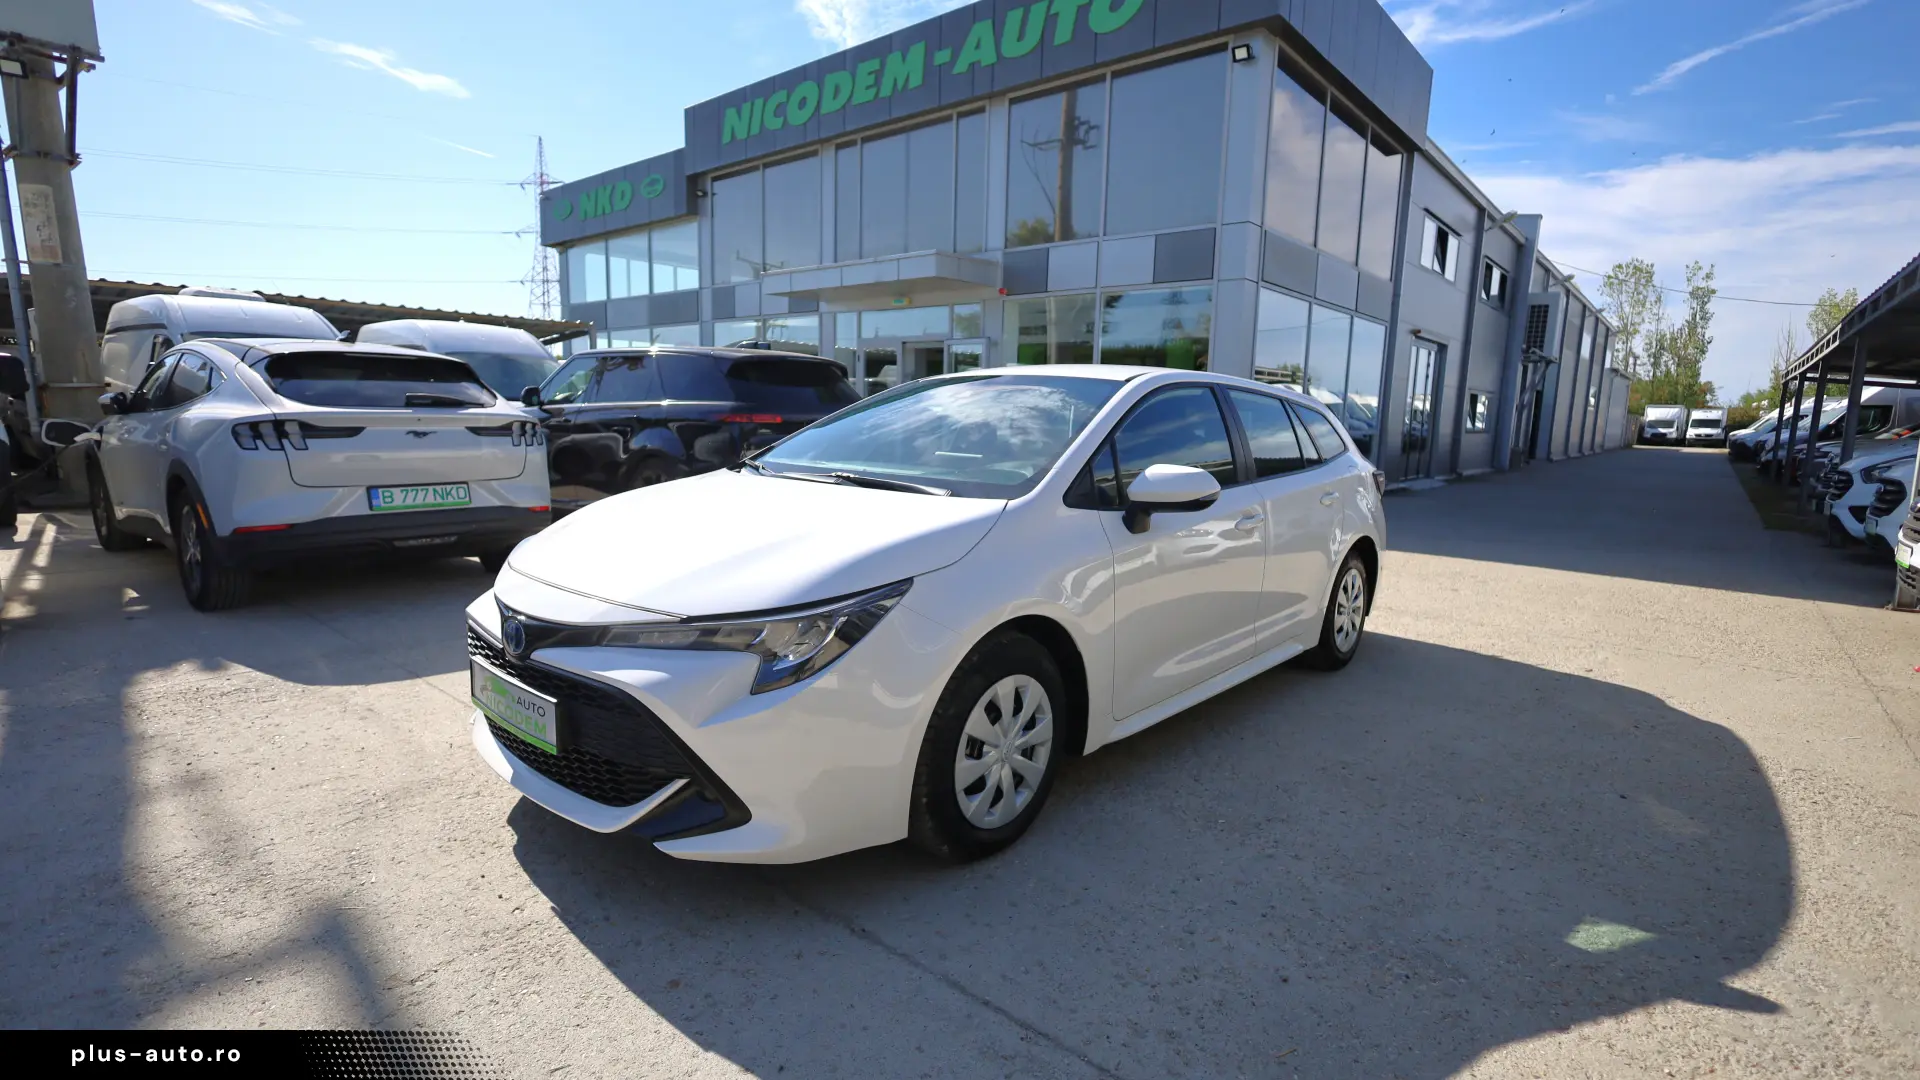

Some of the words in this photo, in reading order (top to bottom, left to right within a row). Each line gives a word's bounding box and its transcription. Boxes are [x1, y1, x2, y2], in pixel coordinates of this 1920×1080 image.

[579, 180, 633, 221] NKD
[381, 490, 394, 504] B
[400, 488, 429, 503] 777
[432, 486, 467, 500] NKD
[486, 691, 547, 739] NICODEM
[516, 696, 546, 717] AUTO
